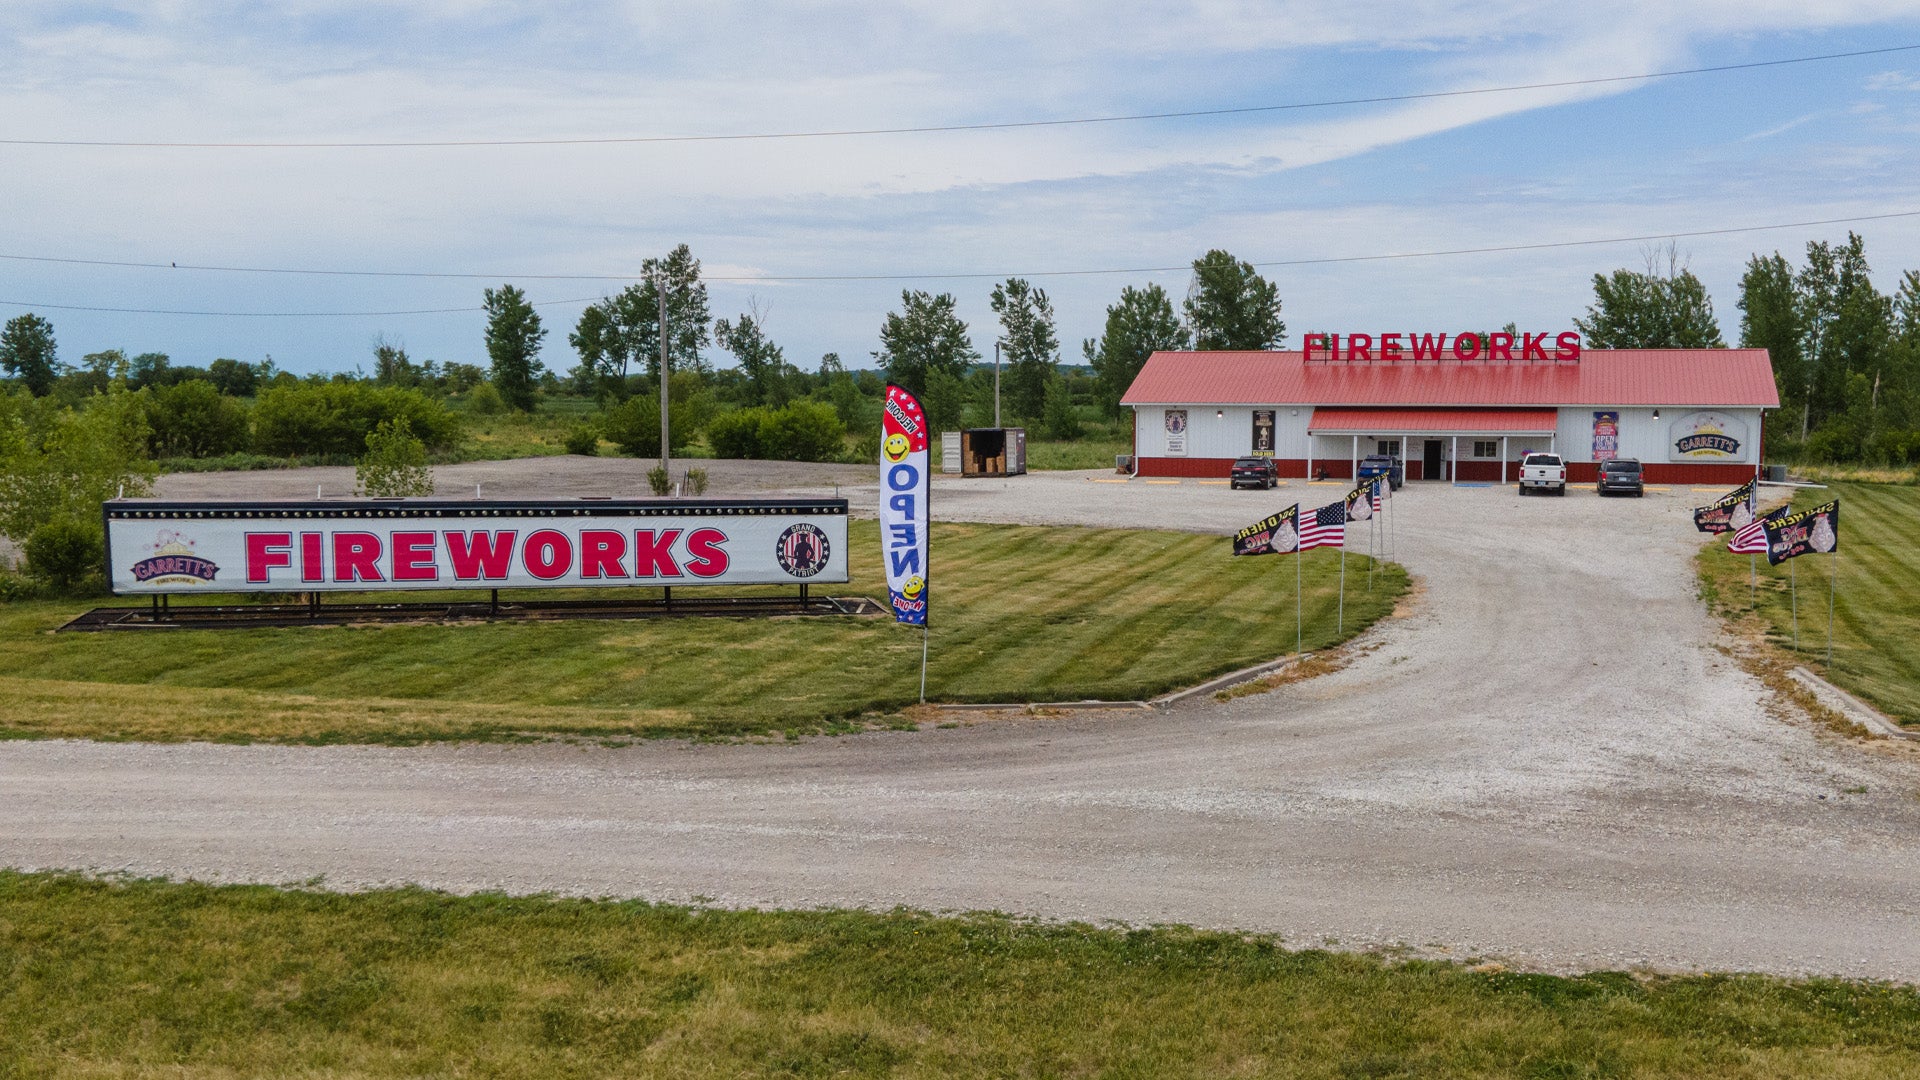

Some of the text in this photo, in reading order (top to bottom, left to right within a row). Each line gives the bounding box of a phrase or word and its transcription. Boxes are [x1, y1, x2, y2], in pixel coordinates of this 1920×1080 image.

[1303, 331, 1581, 361] FIREWORKS
[1680, 436, 1735, 451] GARRETT'S
[790, 524, 816, 533] GRAND
[244, 527, 730, 584] FIREWORKS
[135, 557, 215, 579] GARRETT'S
[788, 566, 819, 577] PATRIOT
